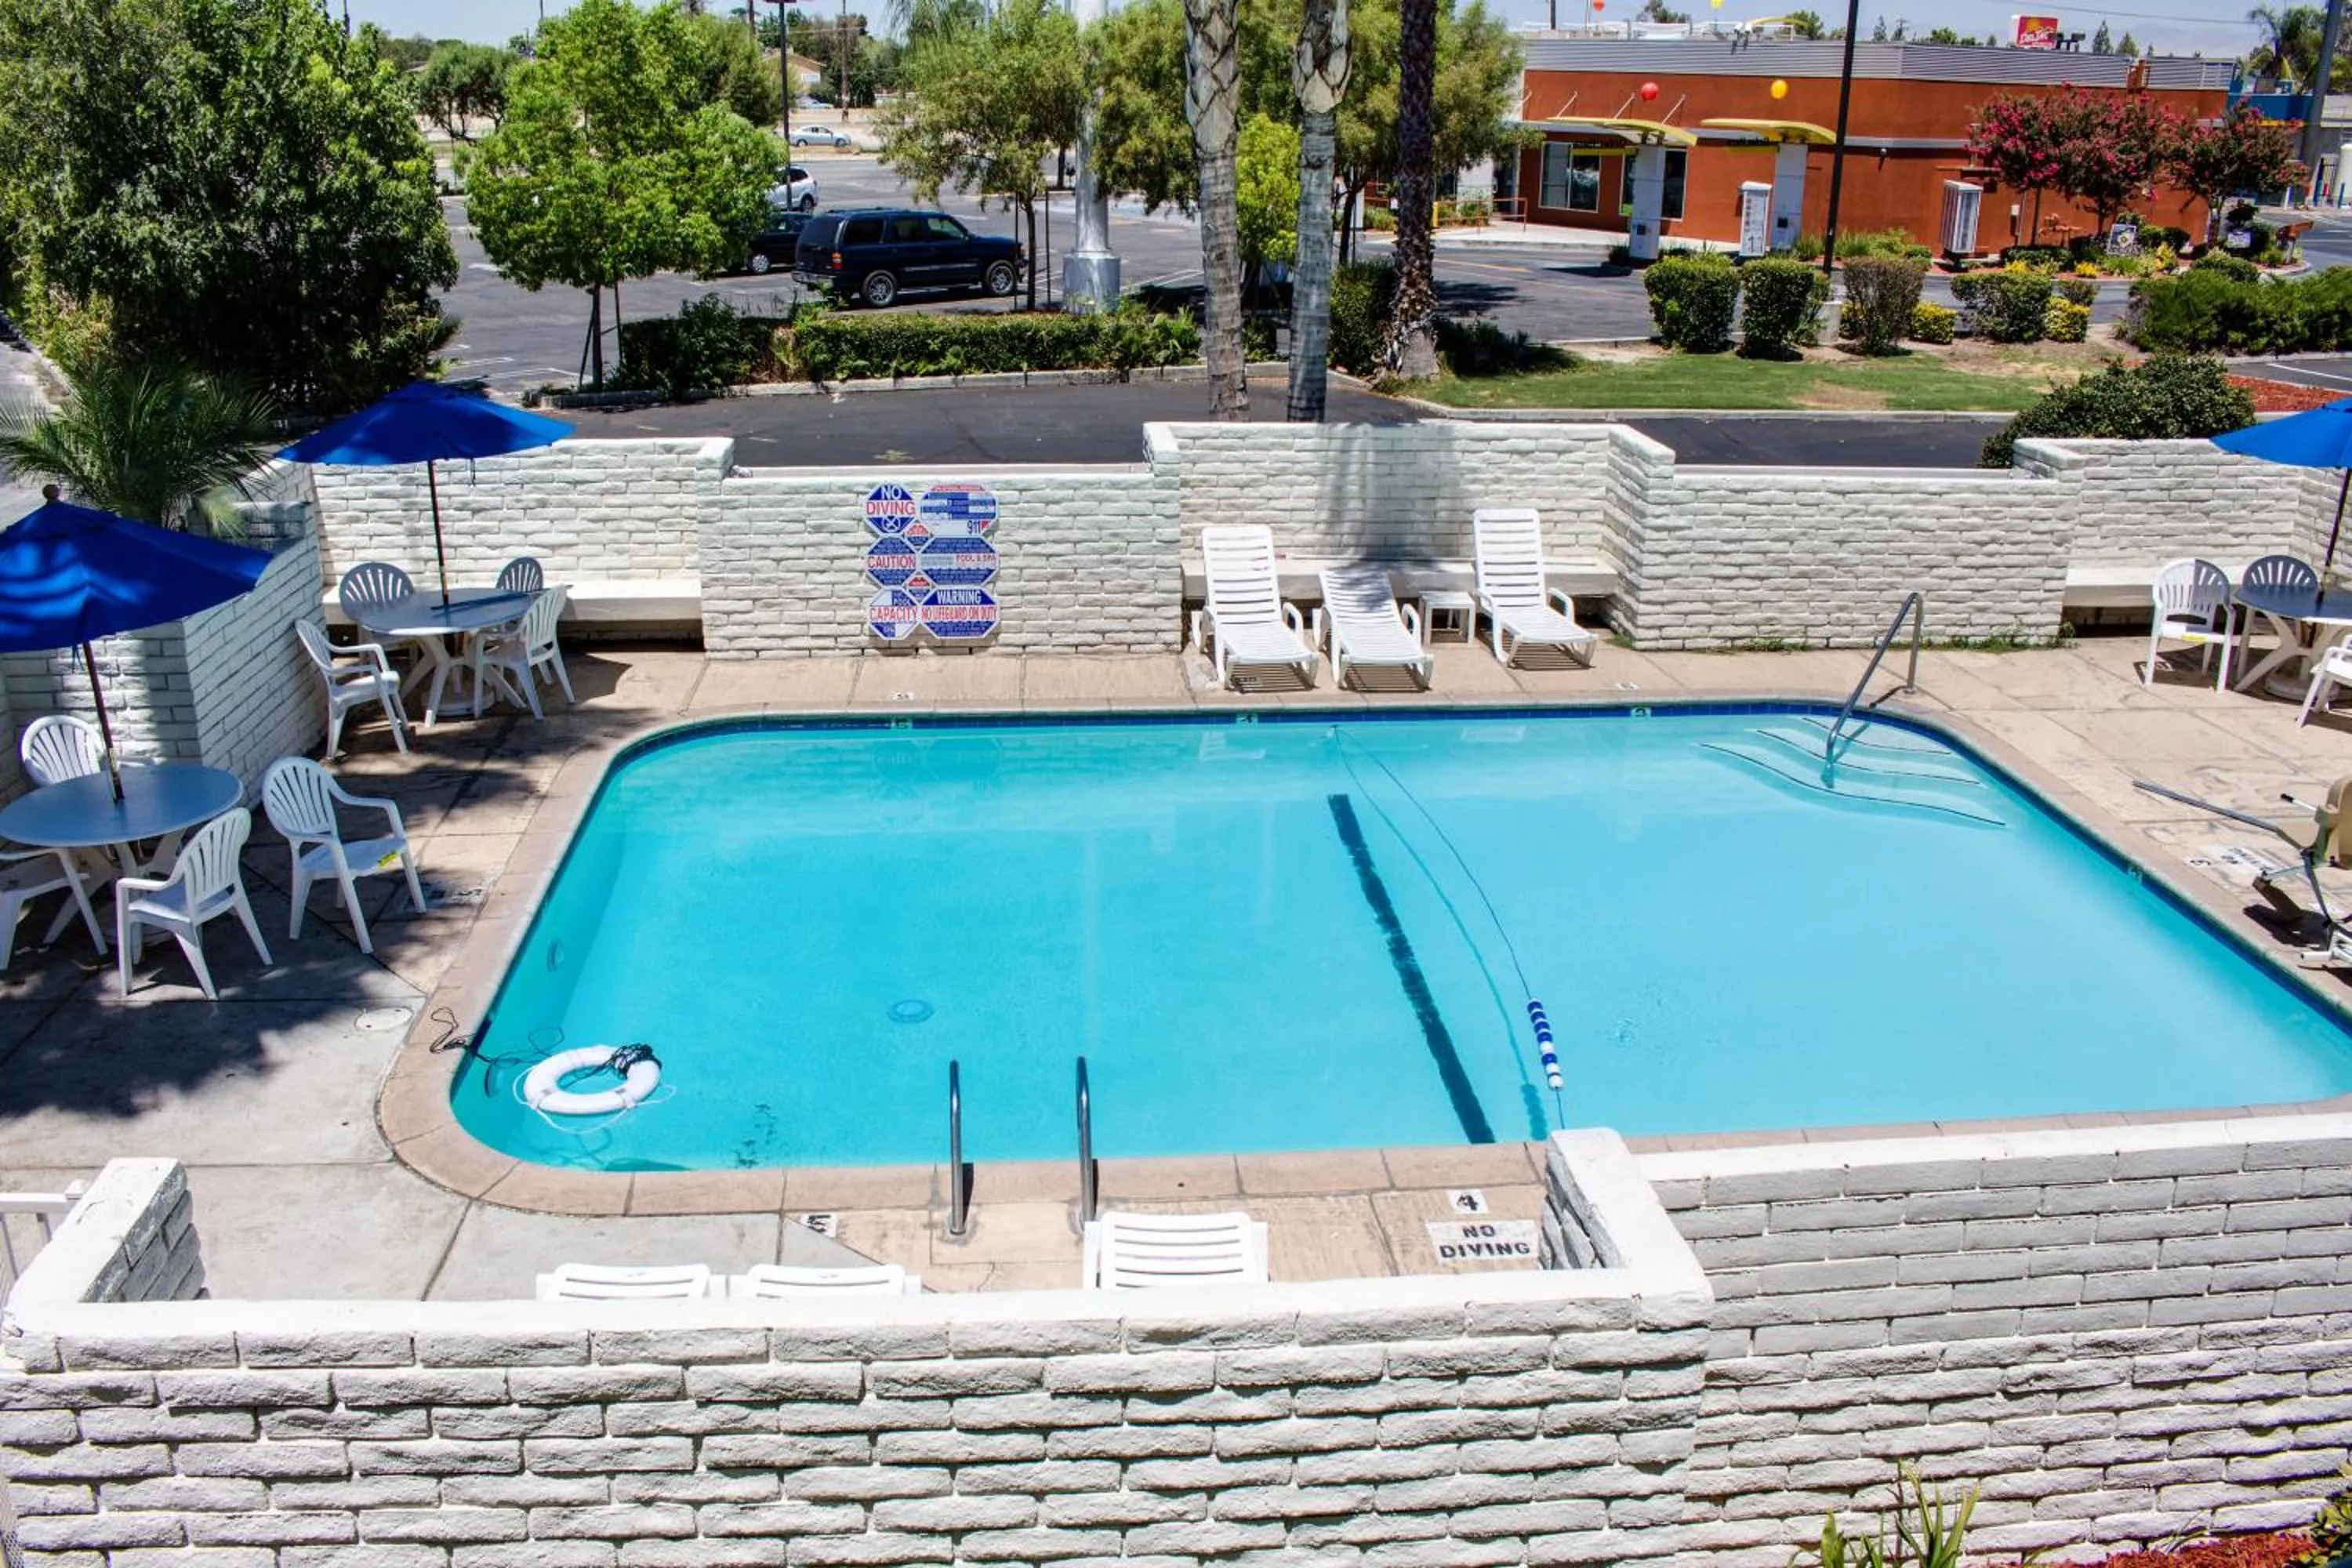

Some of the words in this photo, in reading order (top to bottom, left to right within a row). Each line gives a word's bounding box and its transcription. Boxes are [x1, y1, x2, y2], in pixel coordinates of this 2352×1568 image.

[881, 484, 902, 500] NO
[866, 501, 916, 515] DIVING
[967, 520, 981, 534] 911
[868, 556, 916, 568] CAUTION
[937, 590, 982, 604] WARNING
[870, 608, 918, 621] CAPACITY
[922, 606, 932, 620] NO
[933, 606, 967, 620] LIFEGUARD
[968, 606, 980, 620] ON
[1456, 1194, 1479, 1211] 4
[1462, 1225, 1496, 1238] NO
[1439, 1242, 1531, 1258] DIVING
